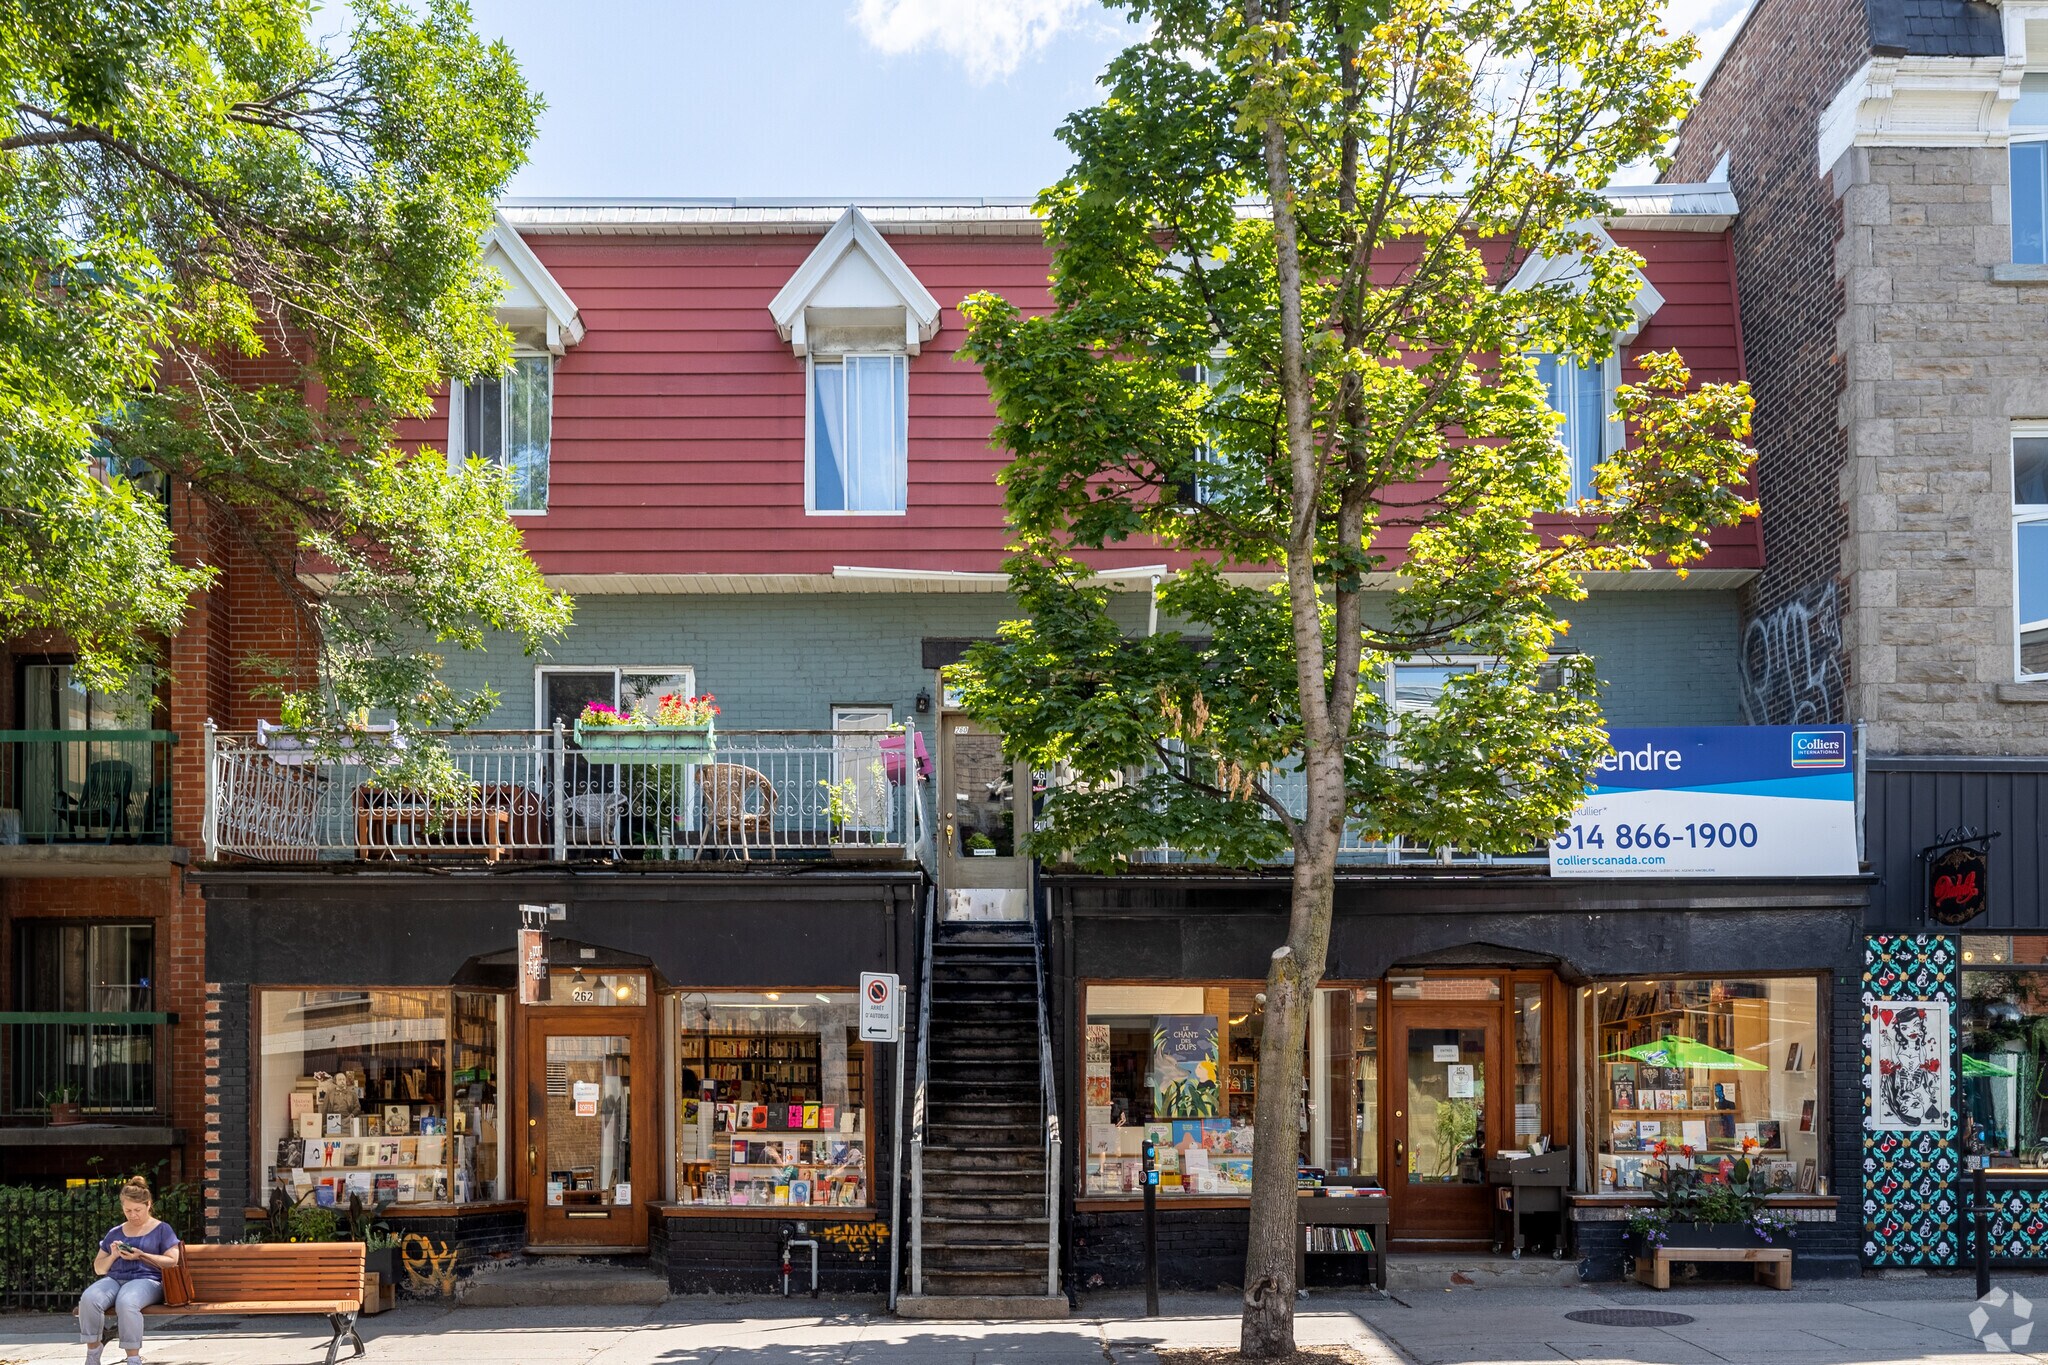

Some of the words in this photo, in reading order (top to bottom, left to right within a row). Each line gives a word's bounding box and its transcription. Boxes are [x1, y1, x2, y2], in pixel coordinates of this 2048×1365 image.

[1797, 738, 1840, 750] Colliers
[1600, 742, 1682, 772] endre
[1555, 824, 1605, 850] 514
[1615, 822, 1758, 849] 866-1900
[1556, 854, 1666, 866] collierscanada.com
[575, 991, 593, 1002] 262
[1173, 1031, 1199, 1039] CHANT
[1175, 1043, 1197, 1051] LOUPS
